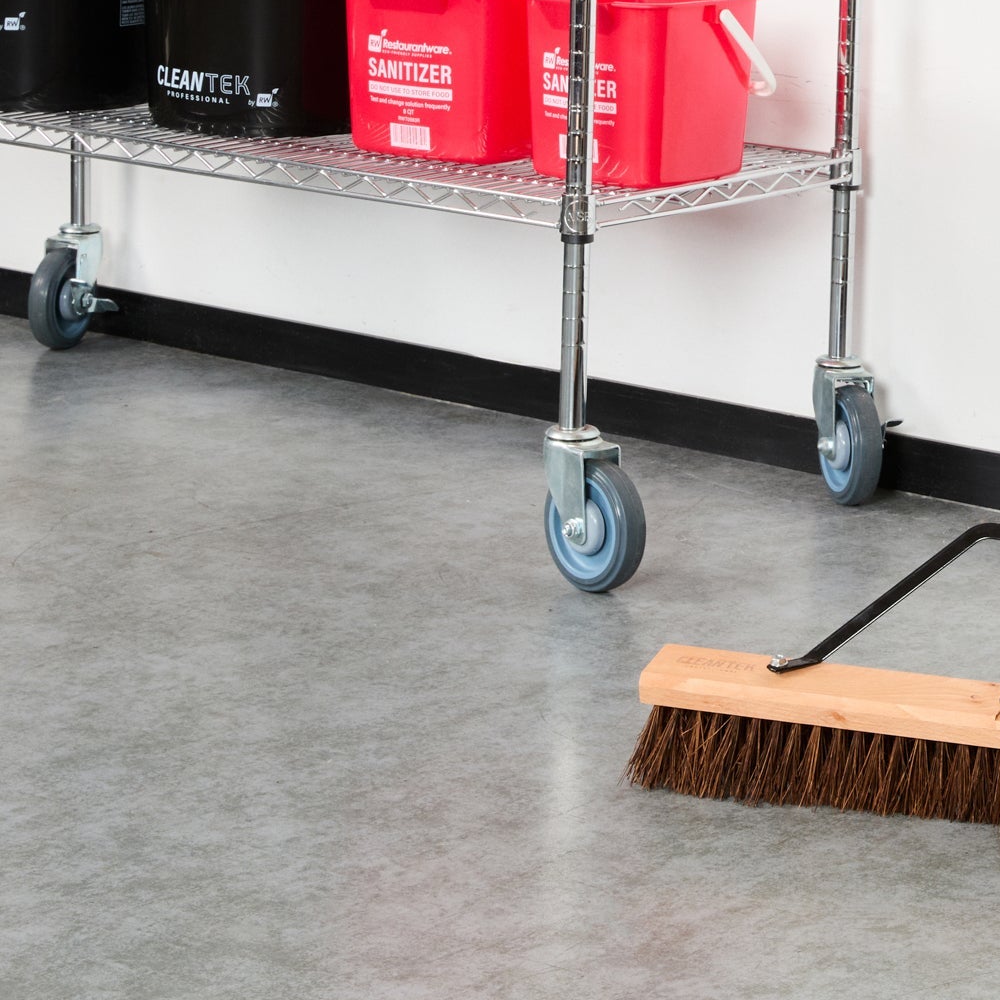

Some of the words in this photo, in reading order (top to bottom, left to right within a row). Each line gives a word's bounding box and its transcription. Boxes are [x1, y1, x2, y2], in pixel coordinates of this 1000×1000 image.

[368, 57, 452, 84] SANITIZER
[157, 65, 250, 95] CLEANTEK
[543, 72, 616, 98] SANER
[167, 90, 230, 104] PROFESSIONAL
[248, 99, 255, 107] by
[388, 98, 404, 107] change
[405, 100, 424, 108] solution
[425, 102, 450, 111] frequently
[676, 656, 756, 671] CLEANTEK
